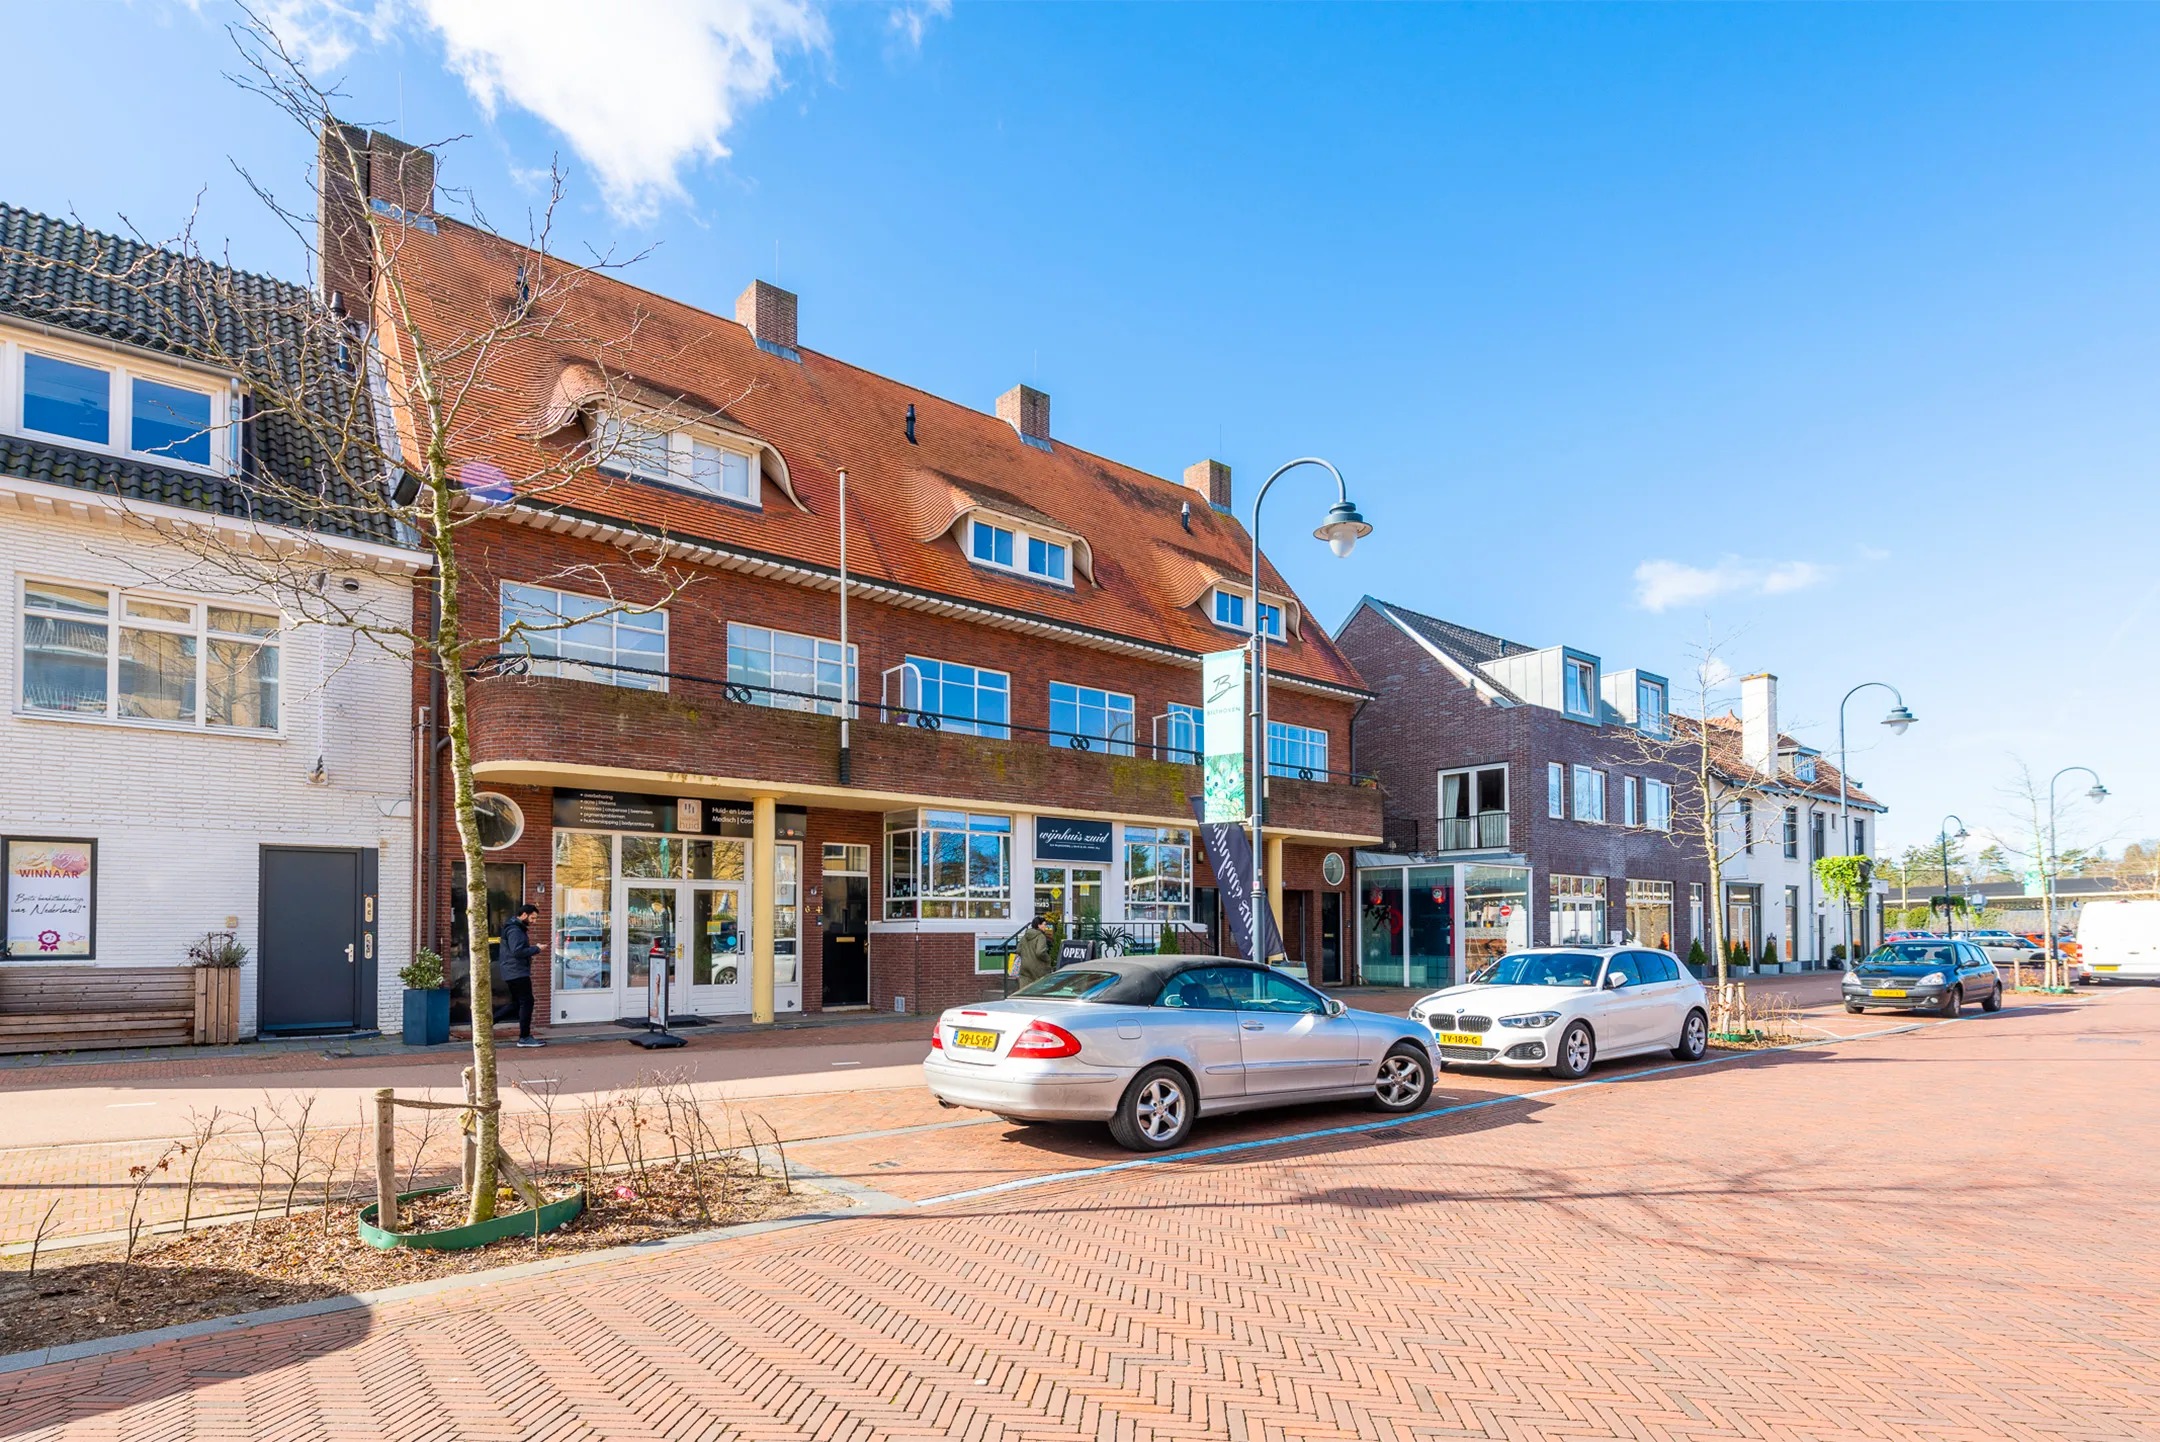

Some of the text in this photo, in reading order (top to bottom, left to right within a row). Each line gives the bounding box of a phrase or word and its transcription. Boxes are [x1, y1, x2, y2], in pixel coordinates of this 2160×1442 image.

[1207, 707, 1240, 716] BILTHOVEN
[738, 808, 754, 816] Laser
[1039, 828, 1109, 843] wijnhuis zuid
[19, 869, 79, 879] WINNAAR
[1063, 947, 1087, 959] OPEN
[959, 1033, 993, 1047] 29-LS-RF
[1442, 1034, 1477, 1045] TV-189-G
